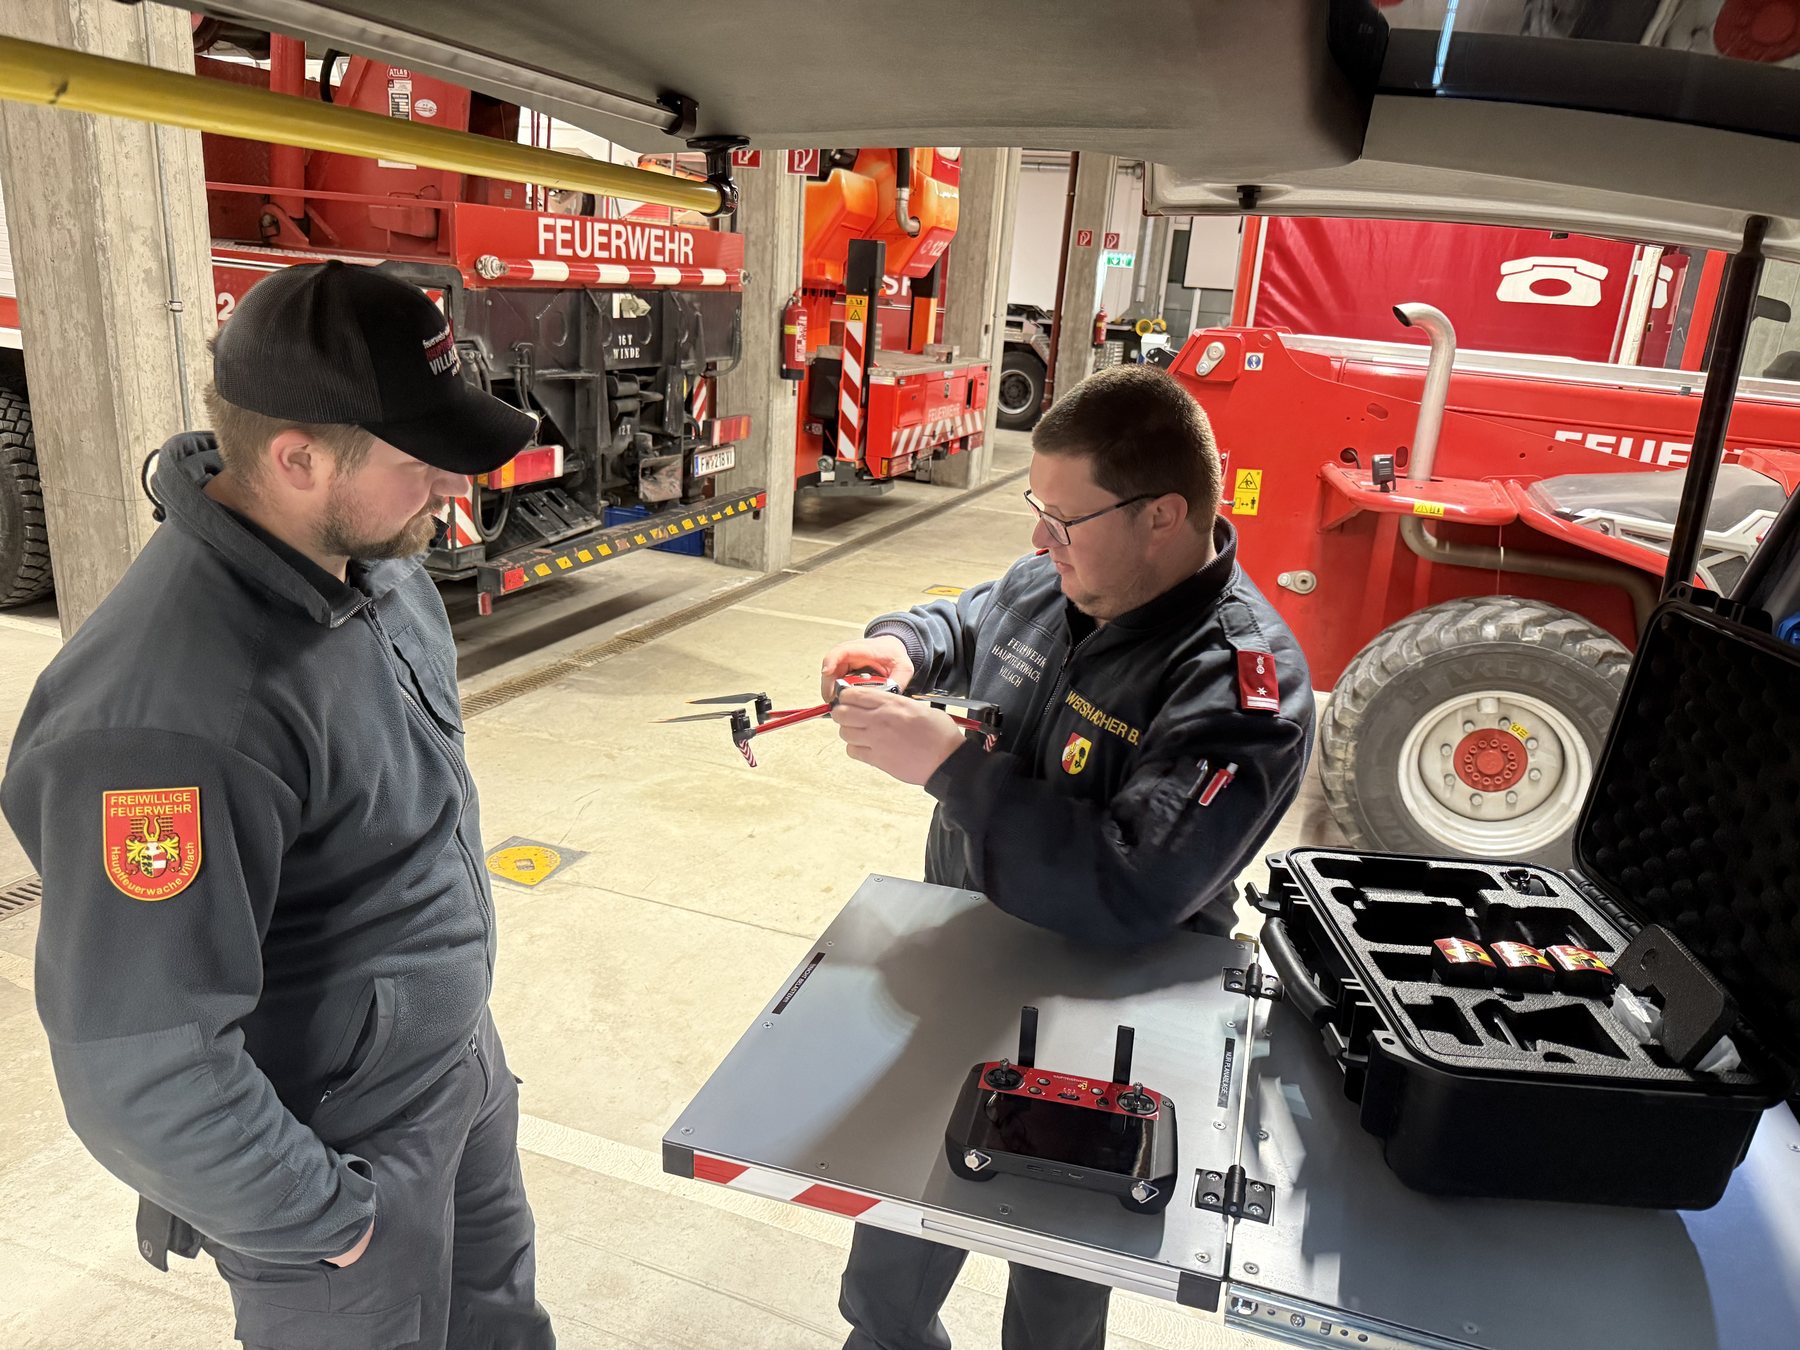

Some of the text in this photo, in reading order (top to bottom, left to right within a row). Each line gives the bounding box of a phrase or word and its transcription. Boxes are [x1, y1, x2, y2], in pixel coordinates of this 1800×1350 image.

[537, 216, 694, 265] FEUERWEHR
[613, 347, 640, 360] WINDE
[1127, 728, 1140, 746] B.
[110, 792, 191, 805] FREIWILLIGE
[110, 804, 192, 817] FEUERWEHR
[111, 842, 195, 896] Hauptfeuerwache Villach
